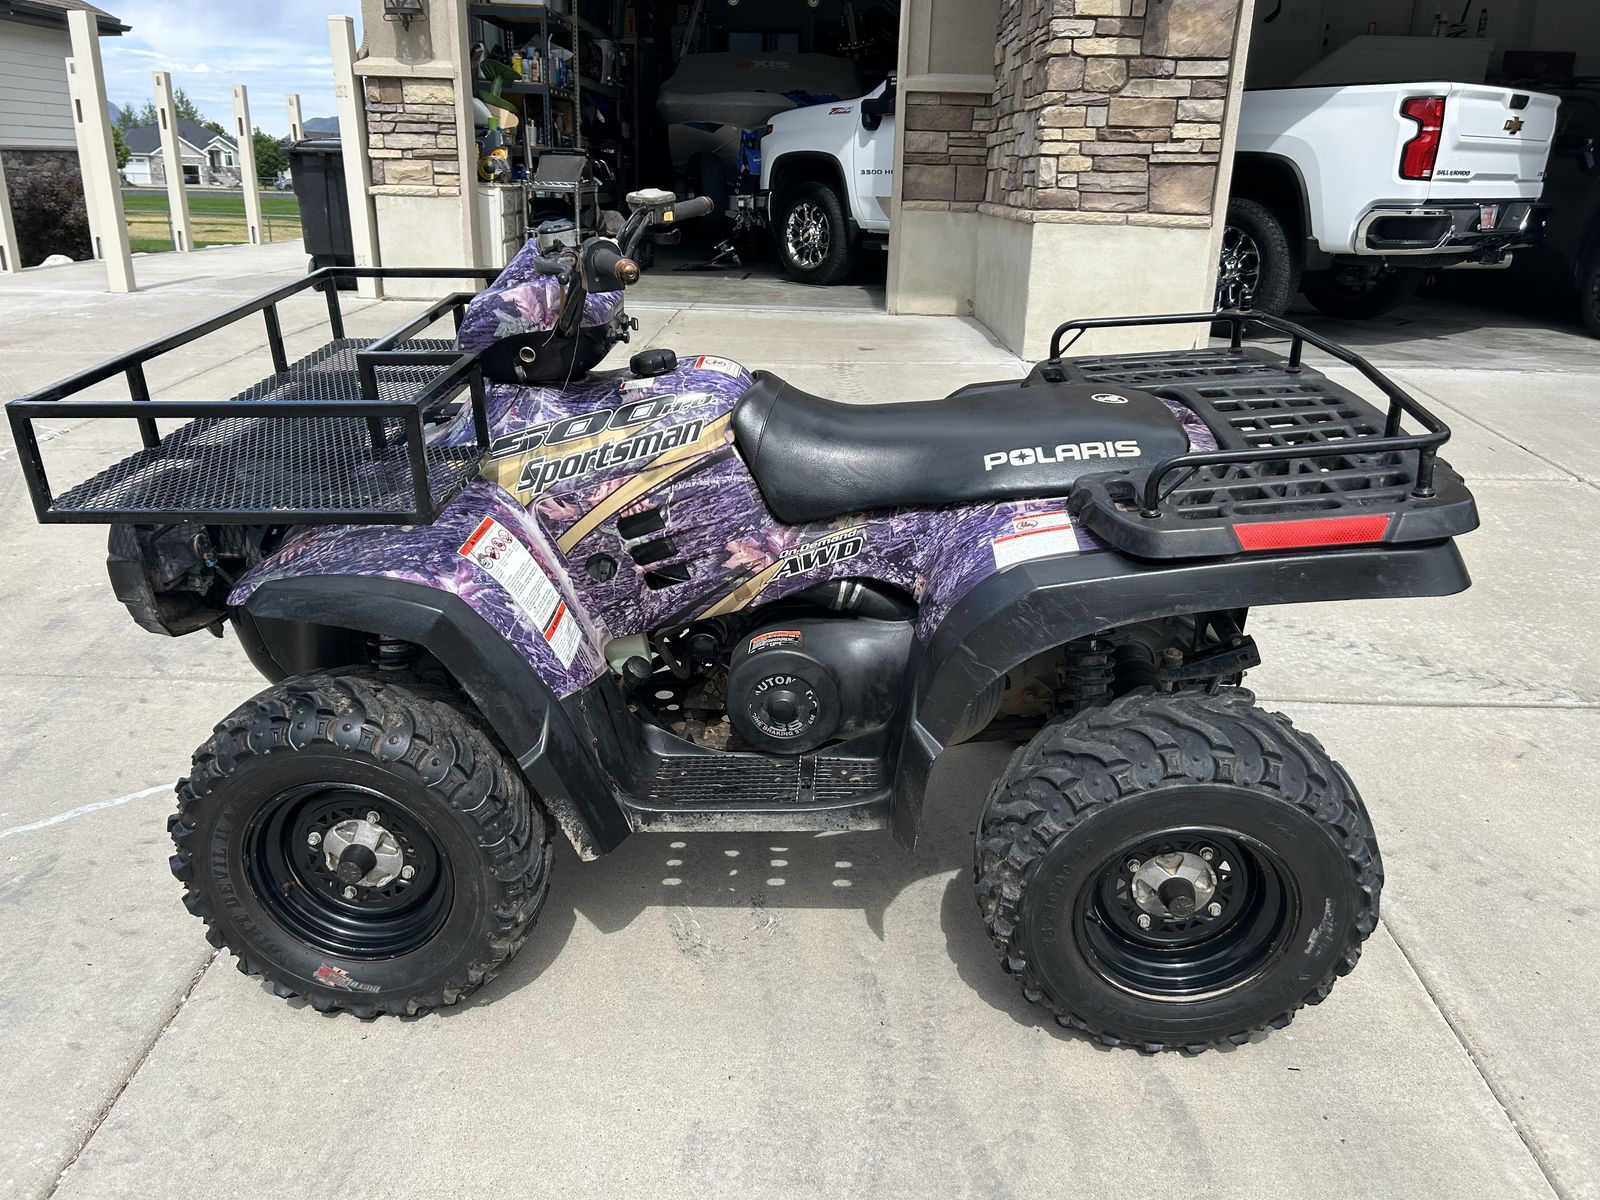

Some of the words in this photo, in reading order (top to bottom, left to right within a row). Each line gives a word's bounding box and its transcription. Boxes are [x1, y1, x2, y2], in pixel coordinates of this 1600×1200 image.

[490, 394, 677, 459] 500
[516, 419, 705, 496] Sportsman
[983, 440, 1142, 472] POLARIS
[770, 536, 863, 581] AWD
